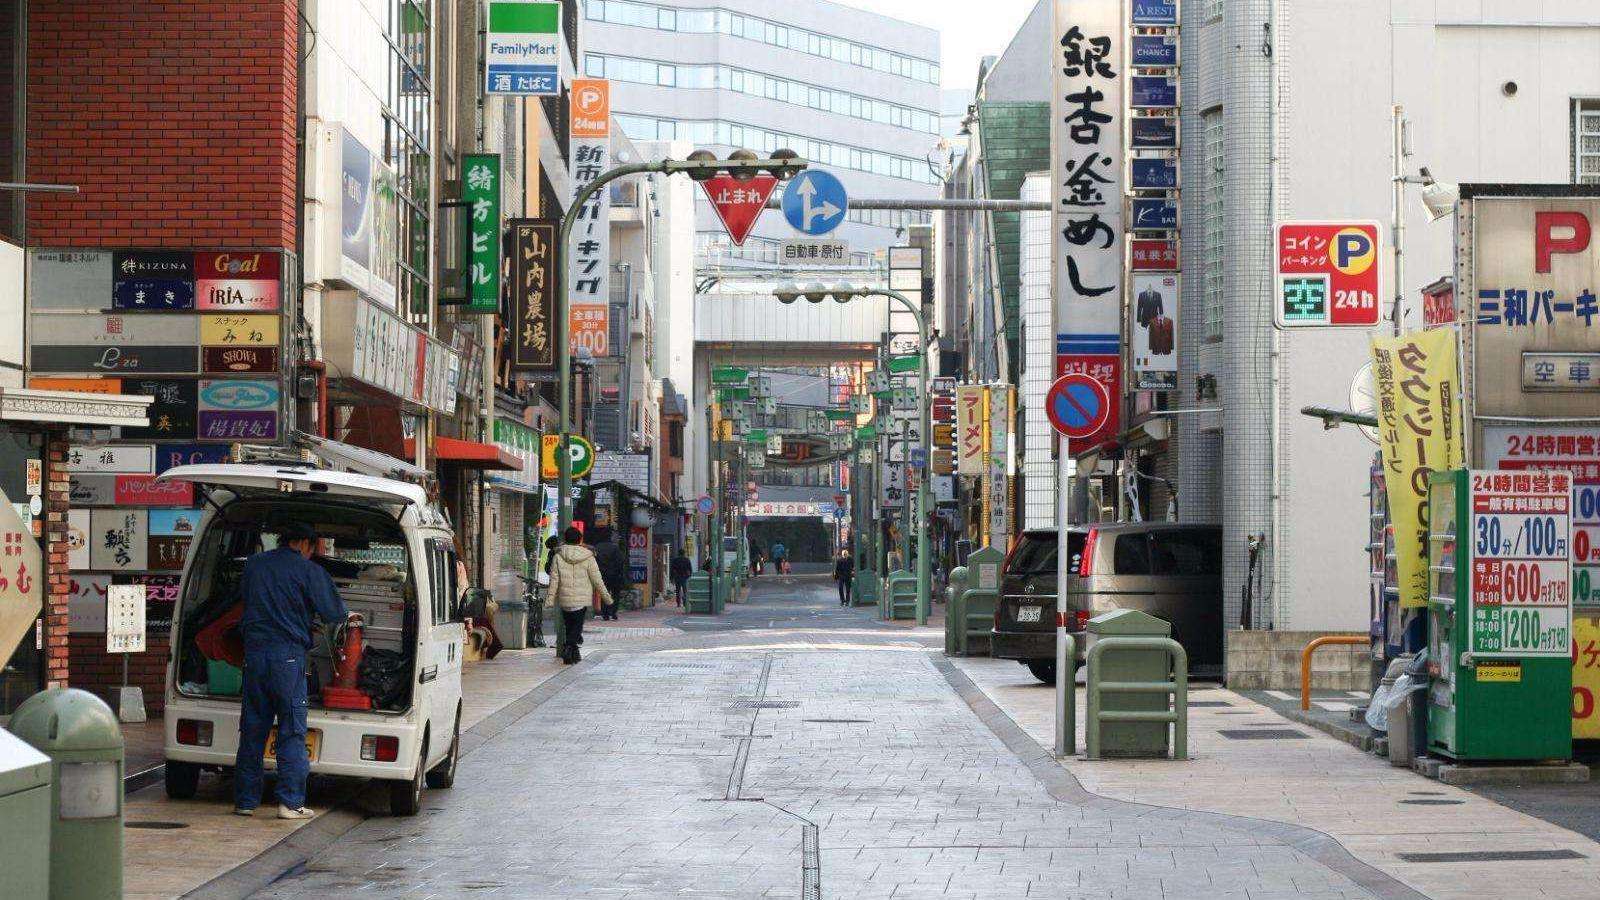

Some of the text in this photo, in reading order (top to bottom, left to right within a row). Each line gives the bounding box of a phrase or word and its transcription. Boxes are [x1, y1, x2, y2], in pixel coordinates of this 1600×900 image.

[490, 42, 556, 57] FamilyMart
[1137, 48, 1171, 56] CHANCE
[494, 75, 552, 91] 酒 たばこ
[581, 91, 599, 109] P
[1060, 25, 1117, 297] 銀杏釜めし
[716, 188, 762, 205] 止まれ
[1285, 235, 1327, 250] コイン
[1535, 211, 1591, 273] P
[1338, 234, 1370, 268] P
[138, 262, 188, 270] KIZUNA
[215, 253, 262, 273] Goal
[1282, 254, 1328, 266] パーキング
[521, 231, 547, 352] 山内農場
[1284, 279, 1325, 320] 空
[1335, 290, 1374, 309] 24h
[214, 317, 249, 326] スナック
[222, 329, 264, 343] みね
[222, 349, 257, 364] SHOWA
[1534, 361, 1591, 384] 空車
[962, 391, 982, 459] ラーメン
[1507, 434, 1600, 455] 24時間営
[1473, 474, 1569, 493] 24時間営業
[1475, 562, 1500, 573] 毎日
[1480, 574, 1500, 585] 7:00
[1475, 609, 1500, 620] 毎日
[1480, 637, 1500, 649] 7:00
